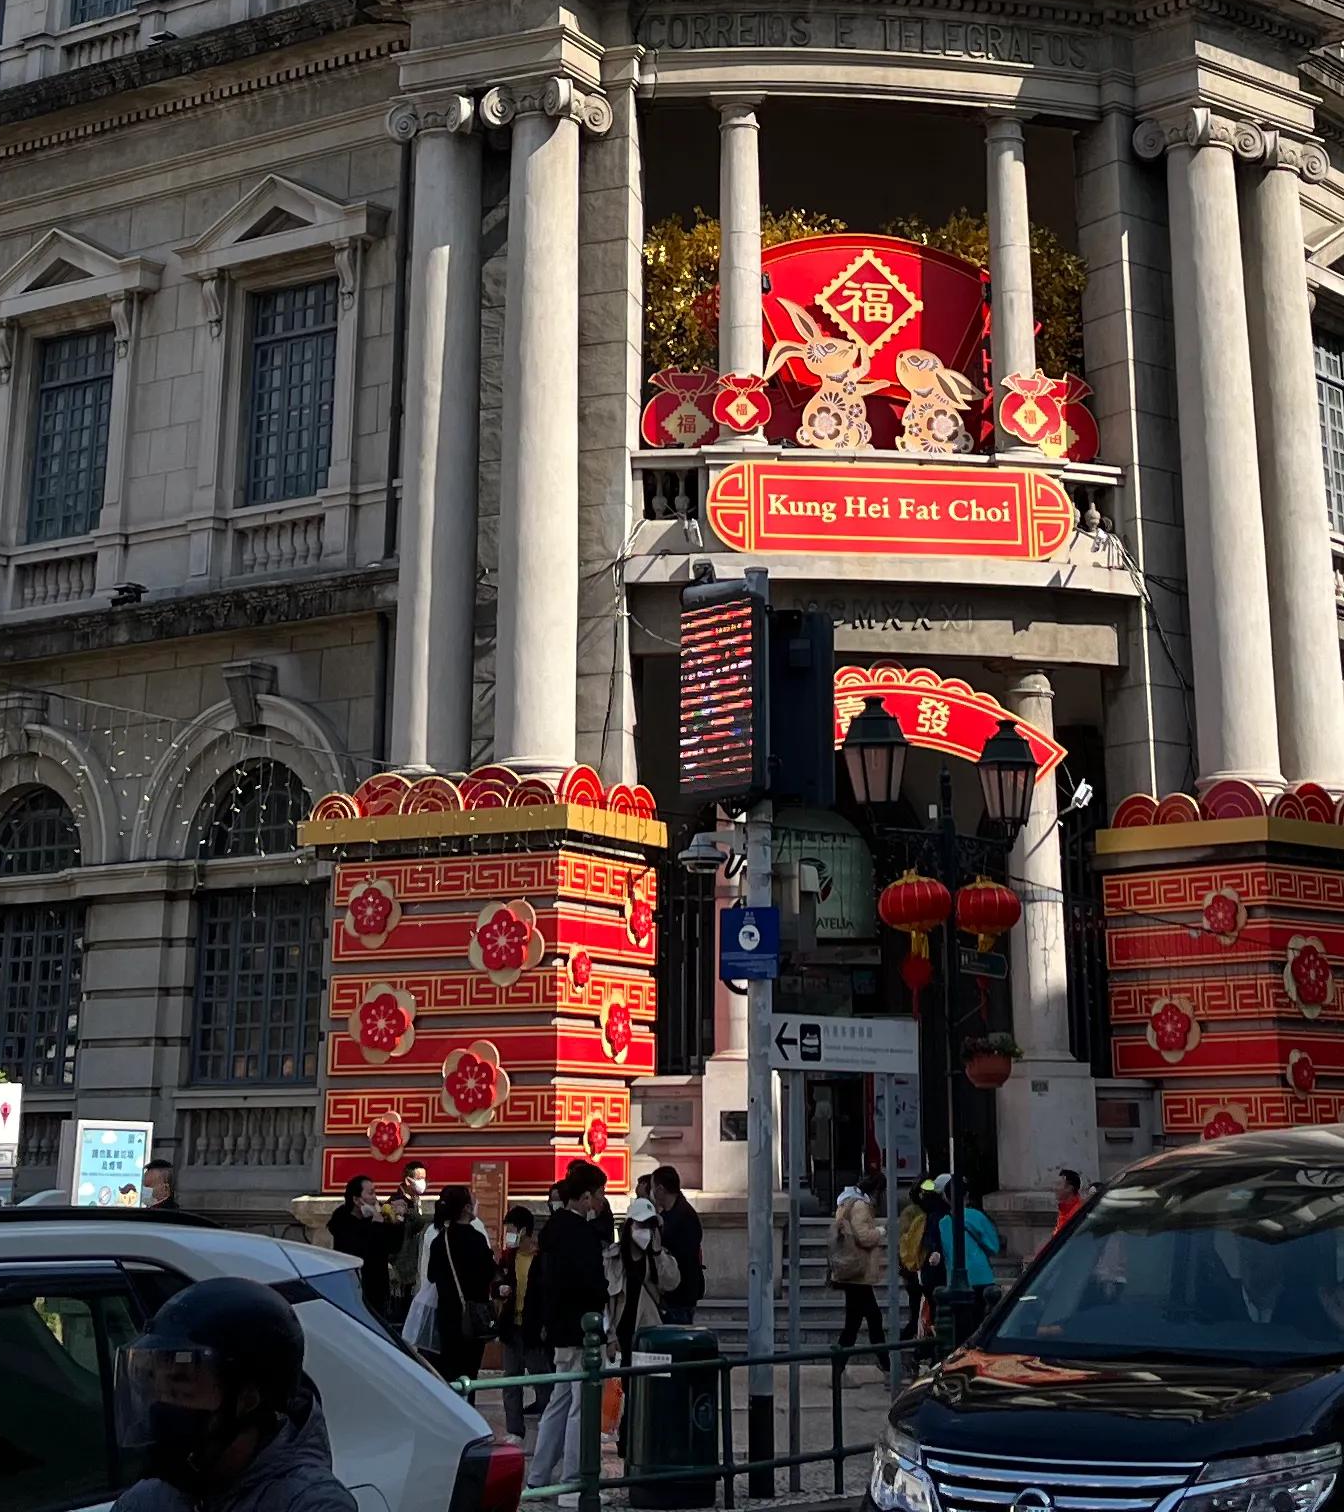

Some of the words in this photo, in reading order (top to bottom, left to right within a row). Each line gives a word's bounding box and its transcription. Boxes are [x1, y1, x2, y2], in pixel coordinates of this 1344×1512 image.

[645, 13, 812, 49] CORREIOS
[834, 13, 856, 49] E
[877, 15, 1087, 69] TELEGRAFOS
[836, 280, 894, 324] 福
[677, 414, 697, 434] 福
[736, 403, 748, 416] 福
[767, 493, 838, 523] Kung
[844, 495, 891, 519] Hei
[898, 497, 941, 521] Fat
[948, 499, 1012, 523] Choi
